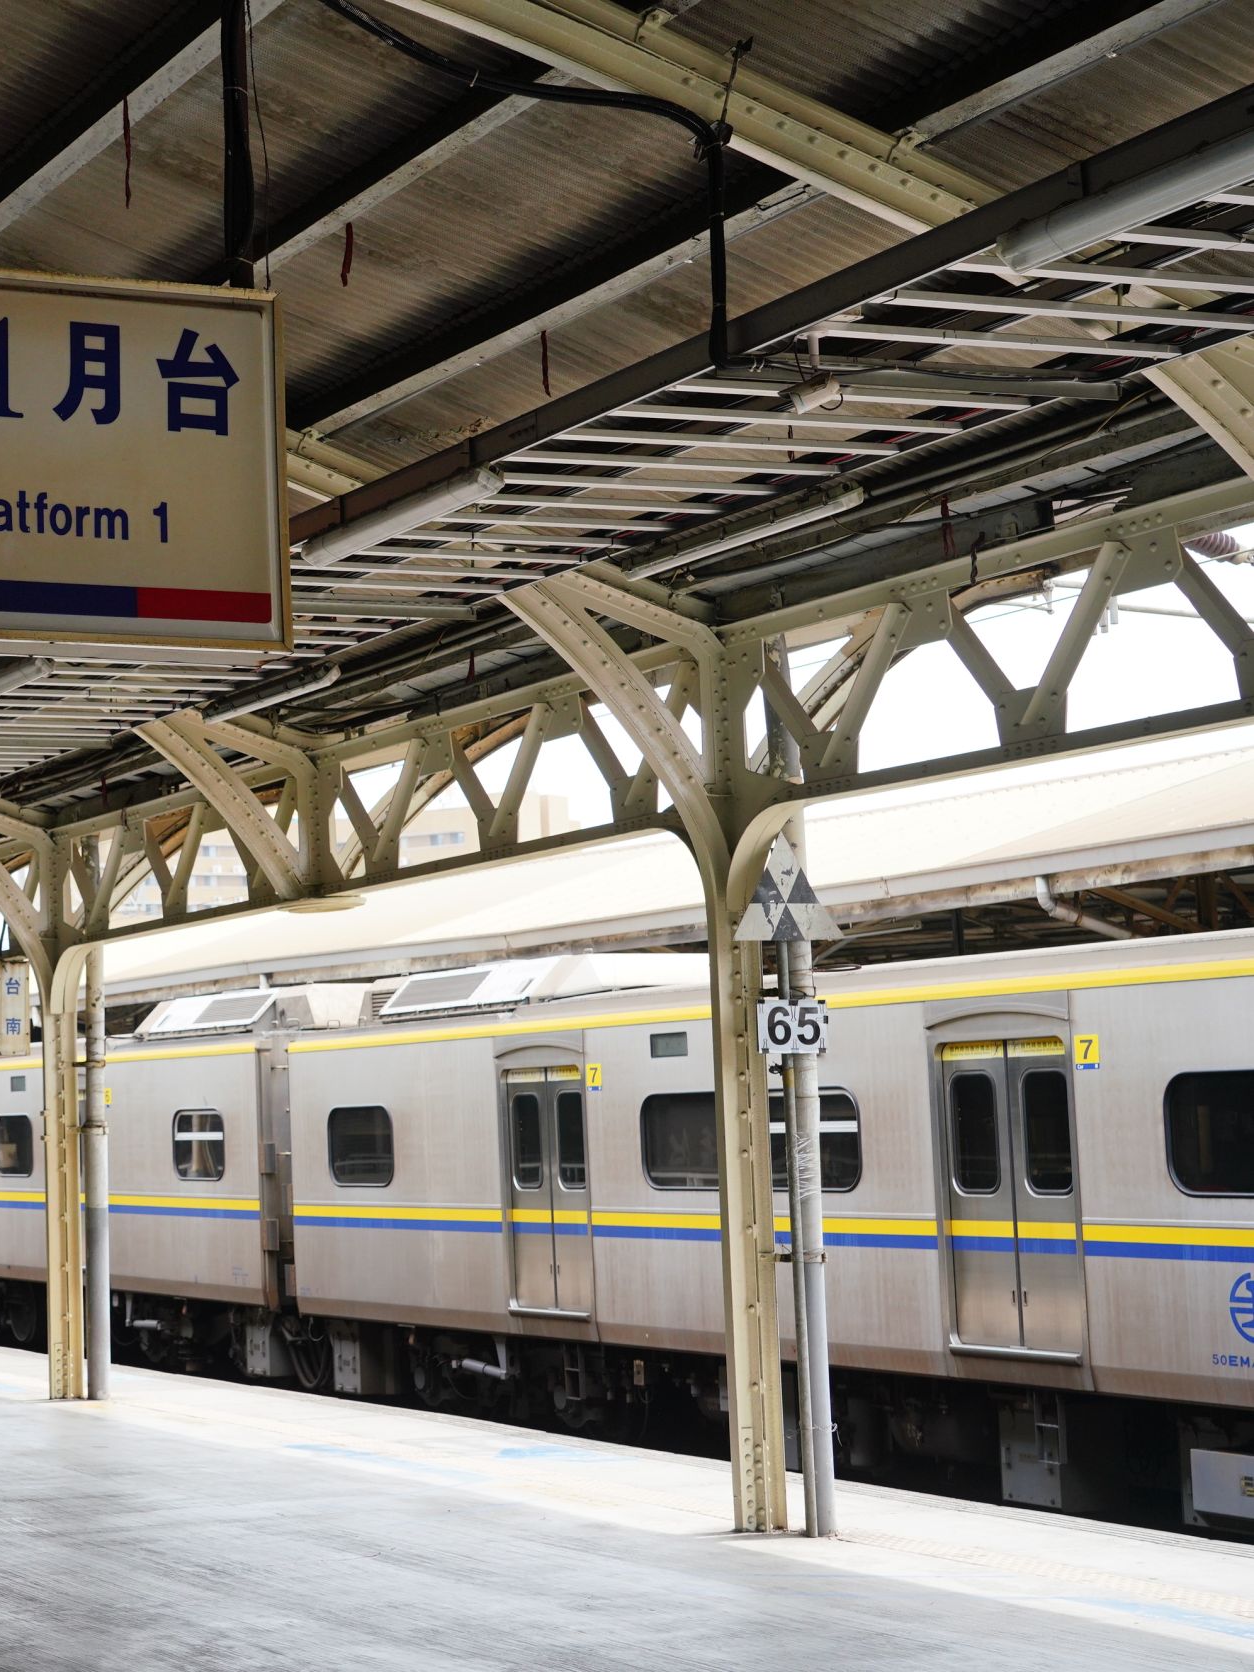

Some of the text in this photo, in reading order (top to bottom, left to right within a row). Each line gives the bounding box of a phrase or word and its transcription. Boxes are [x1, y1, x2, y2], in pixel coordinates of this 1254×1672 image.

[152, 501, 169, 543] 1
[5, 977, 22, 1035] 台南
[767, 1006, 821, 1046] 65
[1079, 1039, 1094, 1060] 7
[589, 1067, 598, 1083] 7
[1212, 1353, 1254, 1368] 50EM
